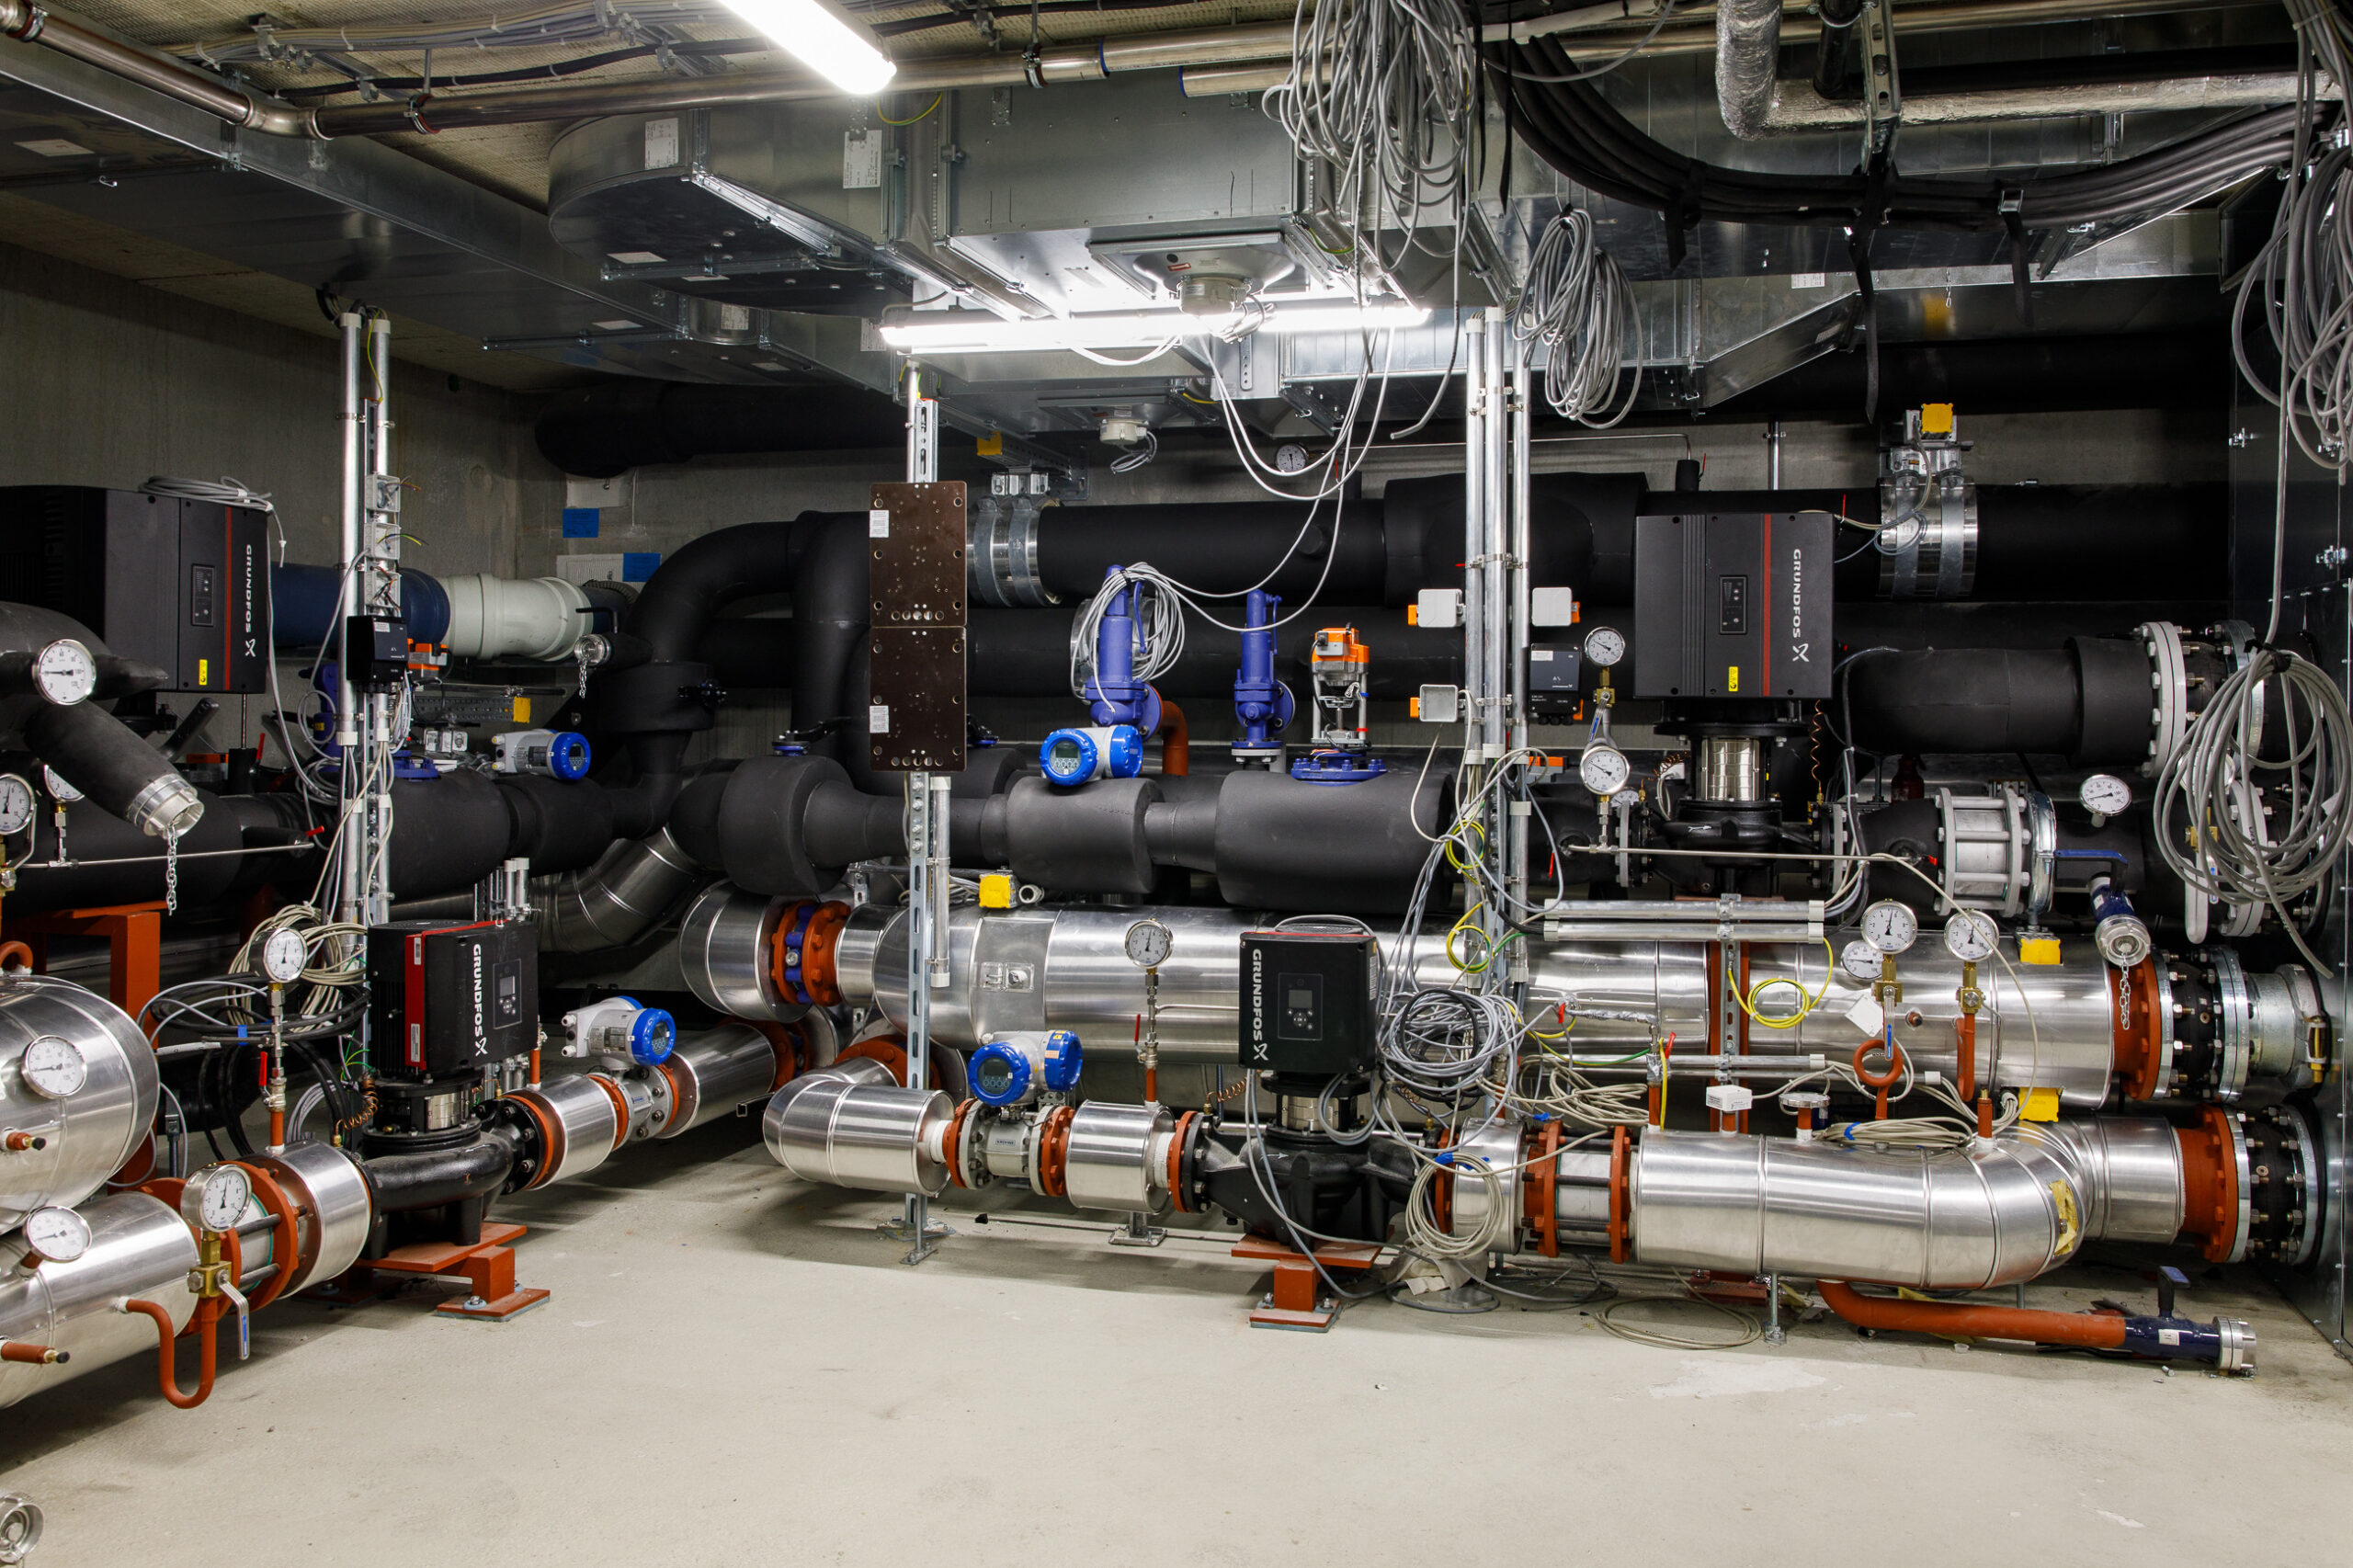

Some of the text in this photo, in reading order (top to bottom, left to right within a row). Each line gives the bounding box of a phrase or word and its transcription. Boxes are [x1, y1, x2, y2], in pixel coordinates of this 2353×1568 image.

[1793, 549, 1802, 638] GRUNDFOS
[473, 944, 483, 1038] GRUNDFOS
[1253, 949, 1262, 1040] GRUNDFOS
